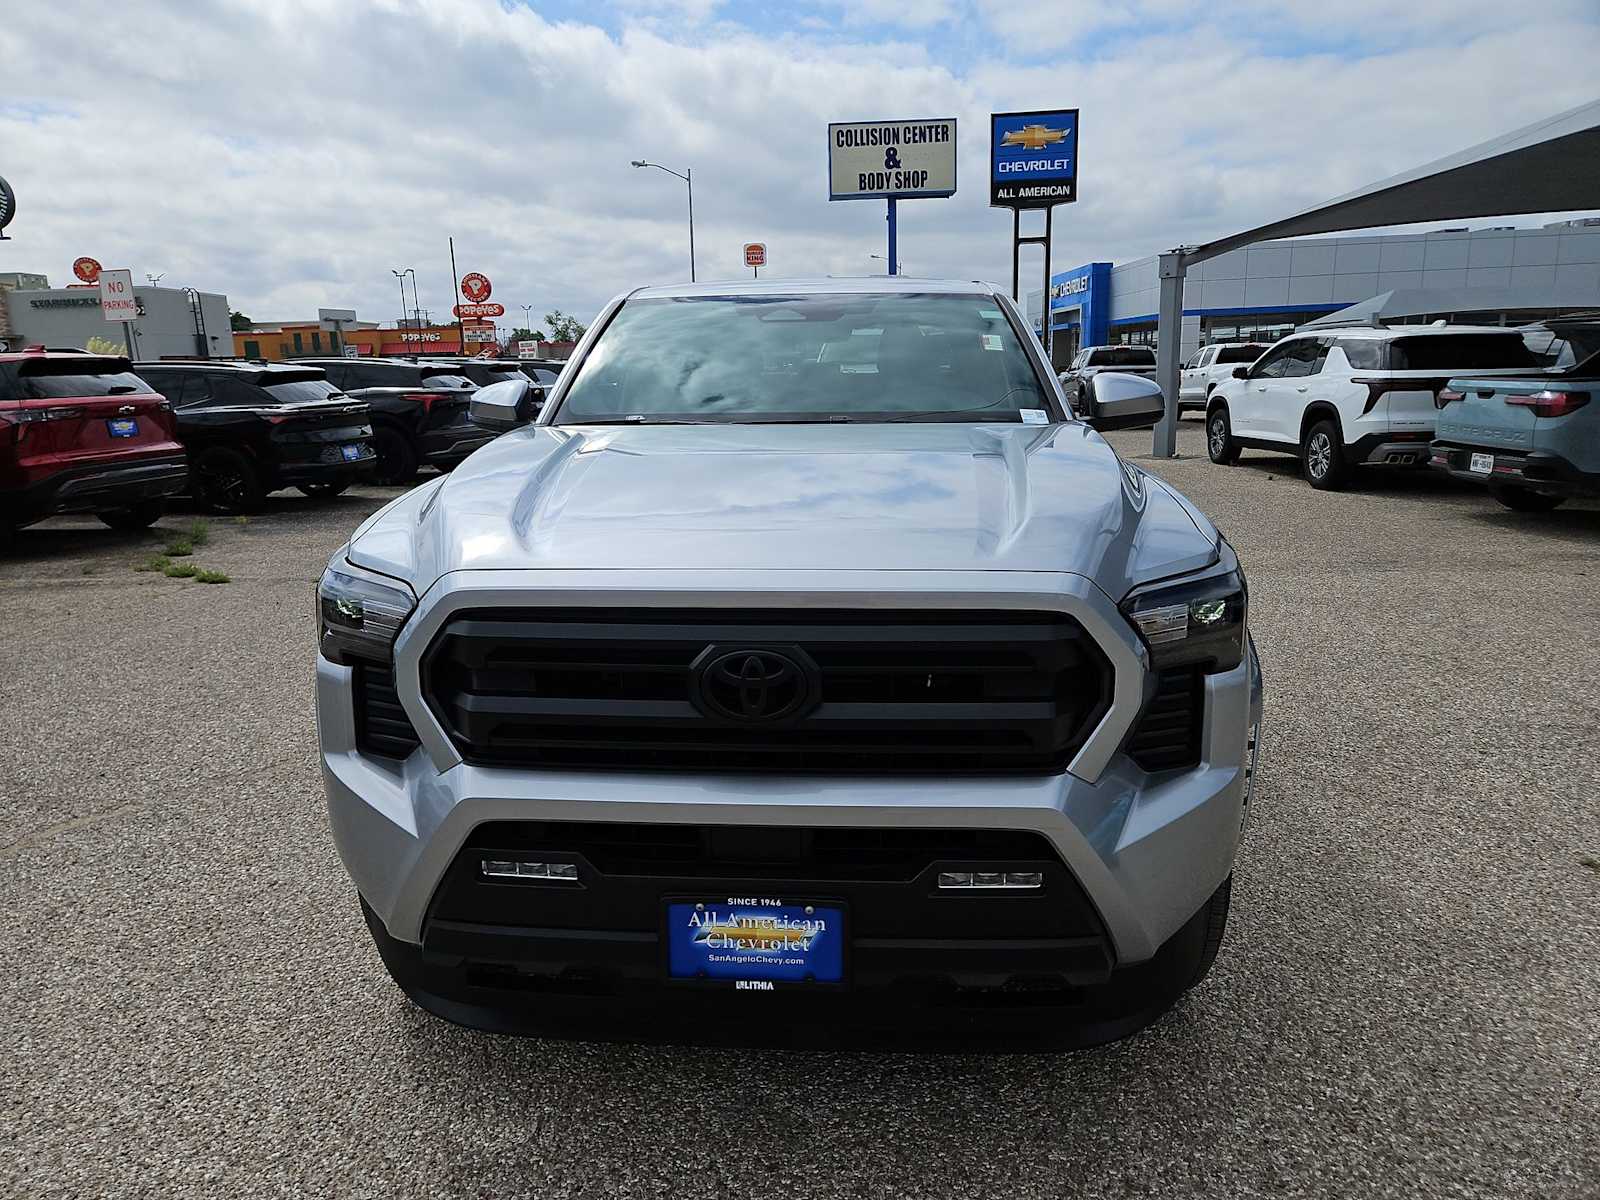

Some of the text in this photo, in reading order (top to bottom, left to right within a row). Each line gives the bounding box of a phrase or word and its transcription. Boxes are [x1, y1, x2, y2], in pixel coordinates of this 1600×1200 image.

[836, 124, 950, 148] COLLISION CENTER
[884, 146, 901, 169] &
[998, 159, 1070, 173] CHEVROLET
[858, 170, 928, 190] BODY SHOP
[997, 185, 1071, 199] ALL AMERICAN
[107, 281, 124, 293] NO
[1061, 276, 1088, 297] CHEVROLET
[103, 300, 134, 310] PARKING
[728, 898, 782, 907] SINCE 1946
[688, 911, 826, 931] All American
[706, 932, 810, 952] Chevrolet
[708, 953, 804, 966] SanAngeloChevy.com
